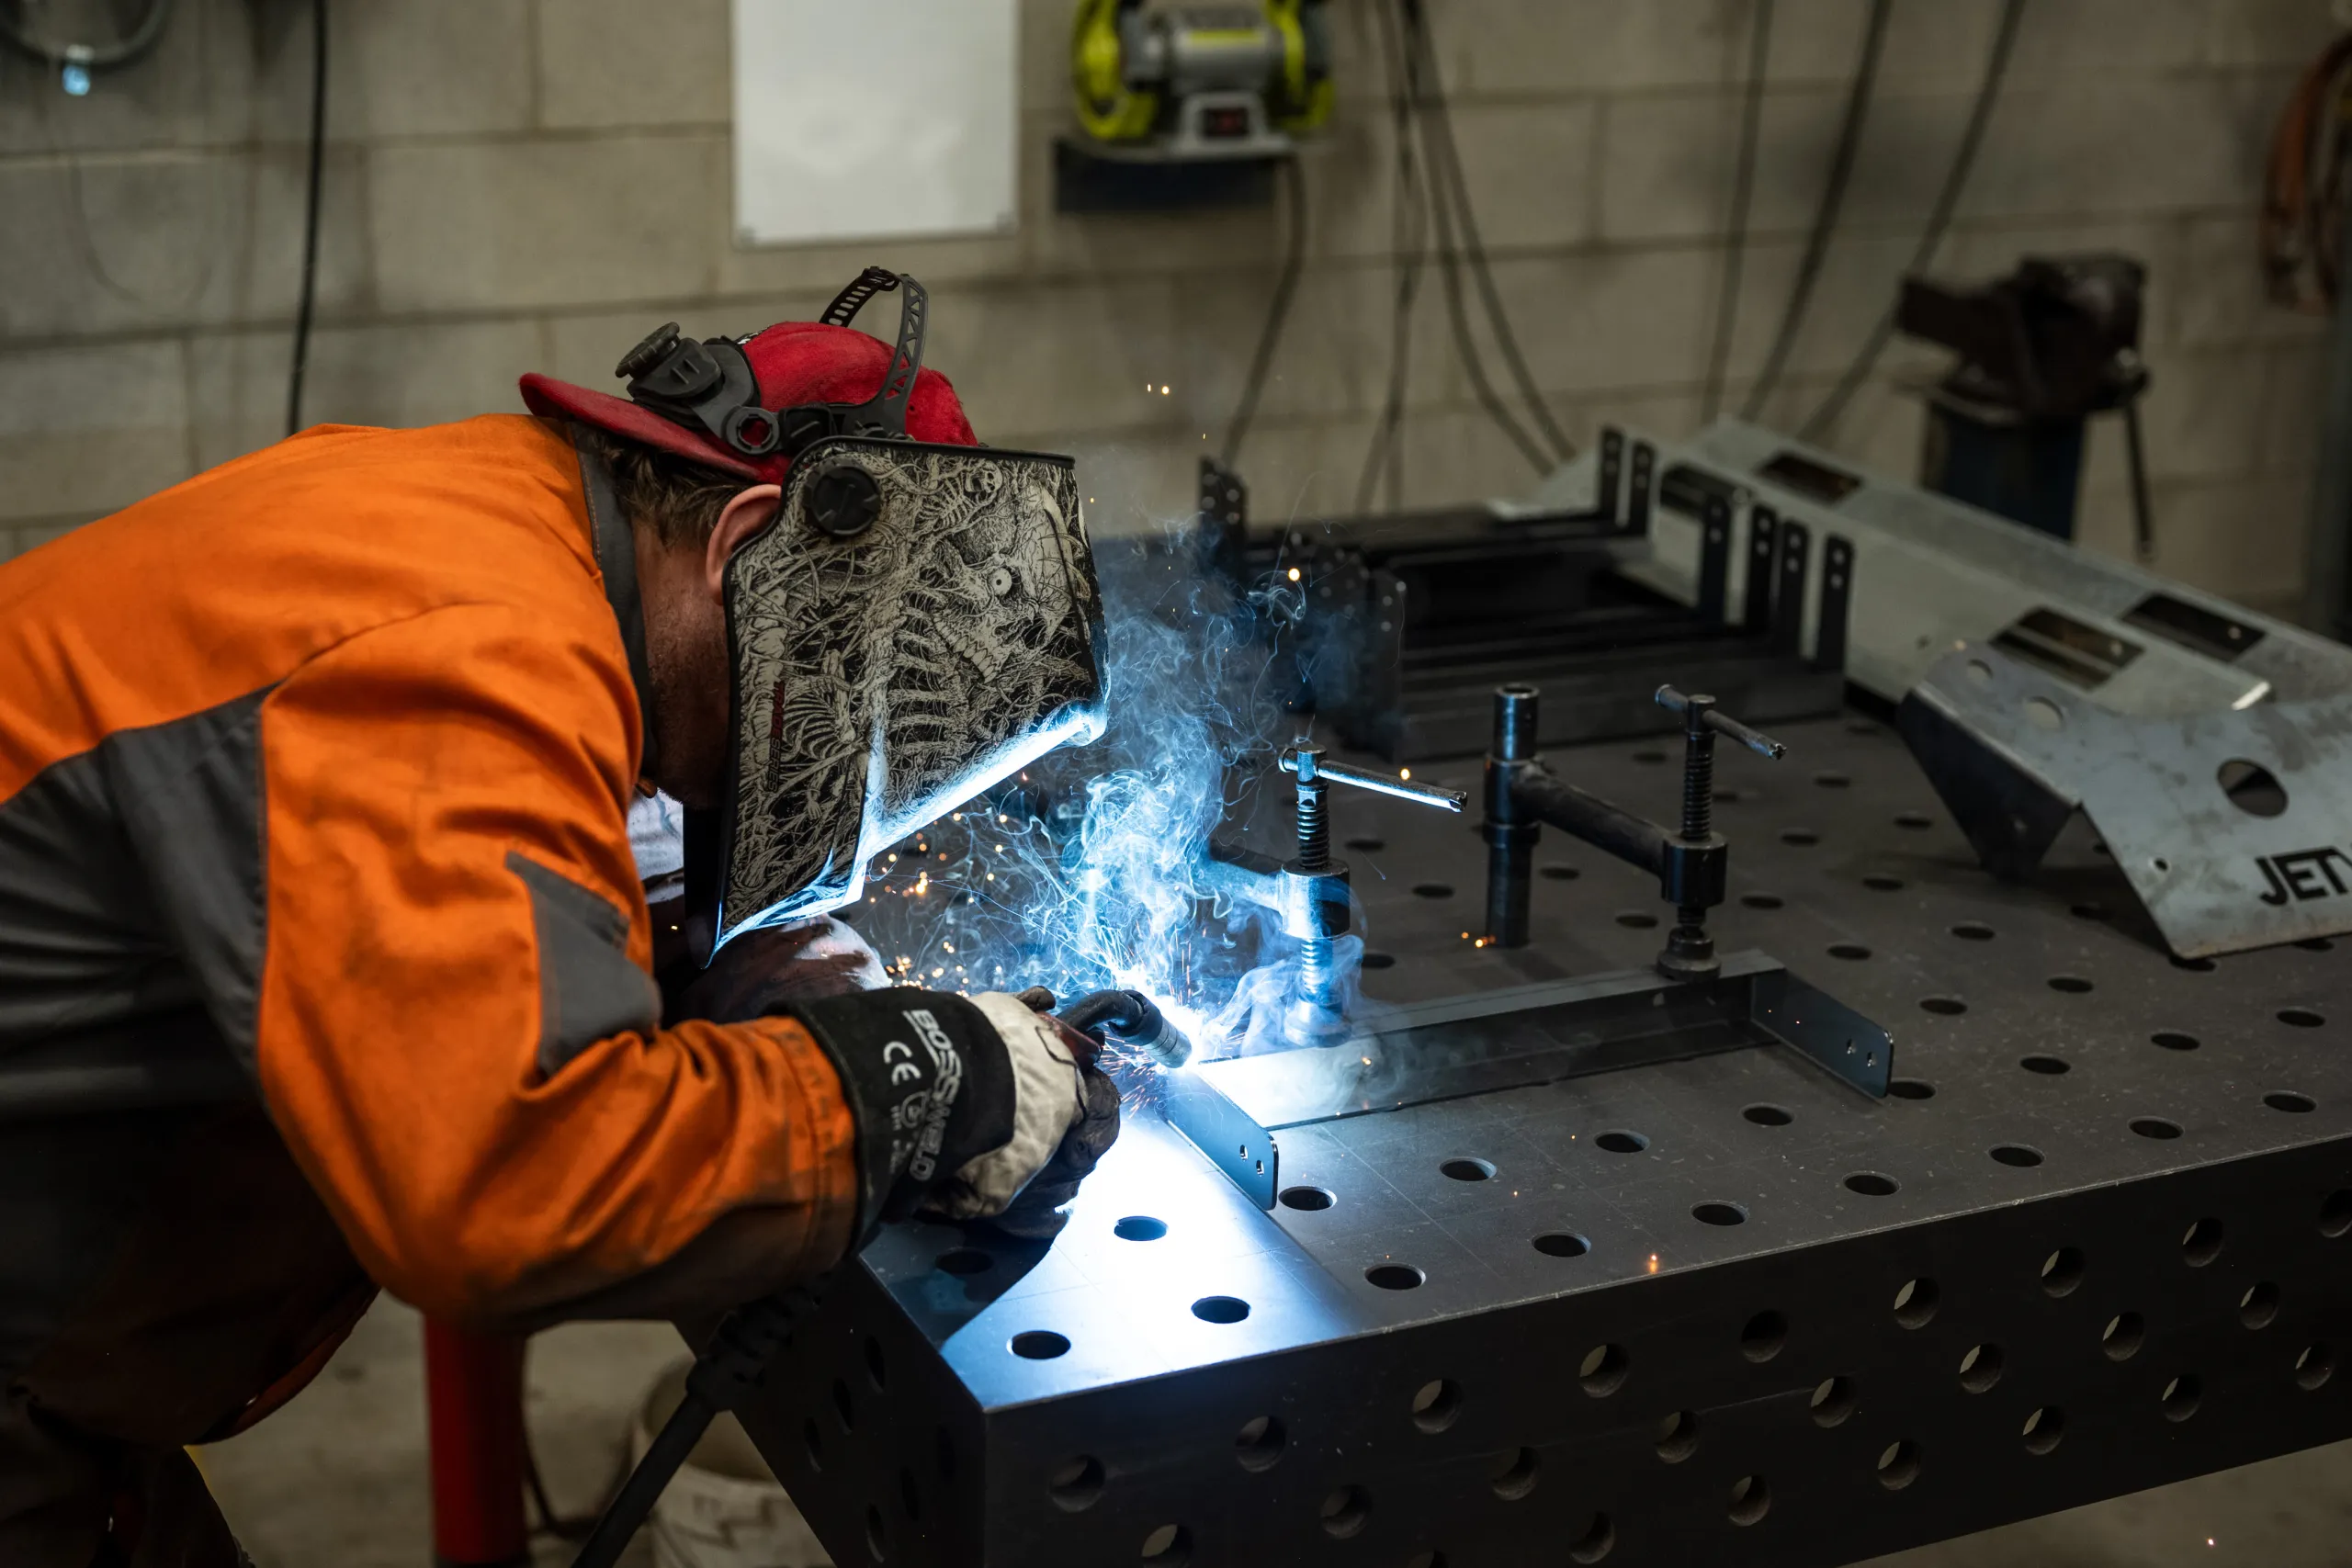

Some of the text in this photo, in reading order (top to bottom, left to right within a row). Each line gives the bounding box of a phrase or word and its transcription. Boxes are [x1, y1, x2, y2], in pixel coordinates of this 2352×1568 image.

[767, 681, 785, 793] TRADE SERIES
[2255, 846, 2352, 905] JET
[883, 1040, 922, 1086] CE
